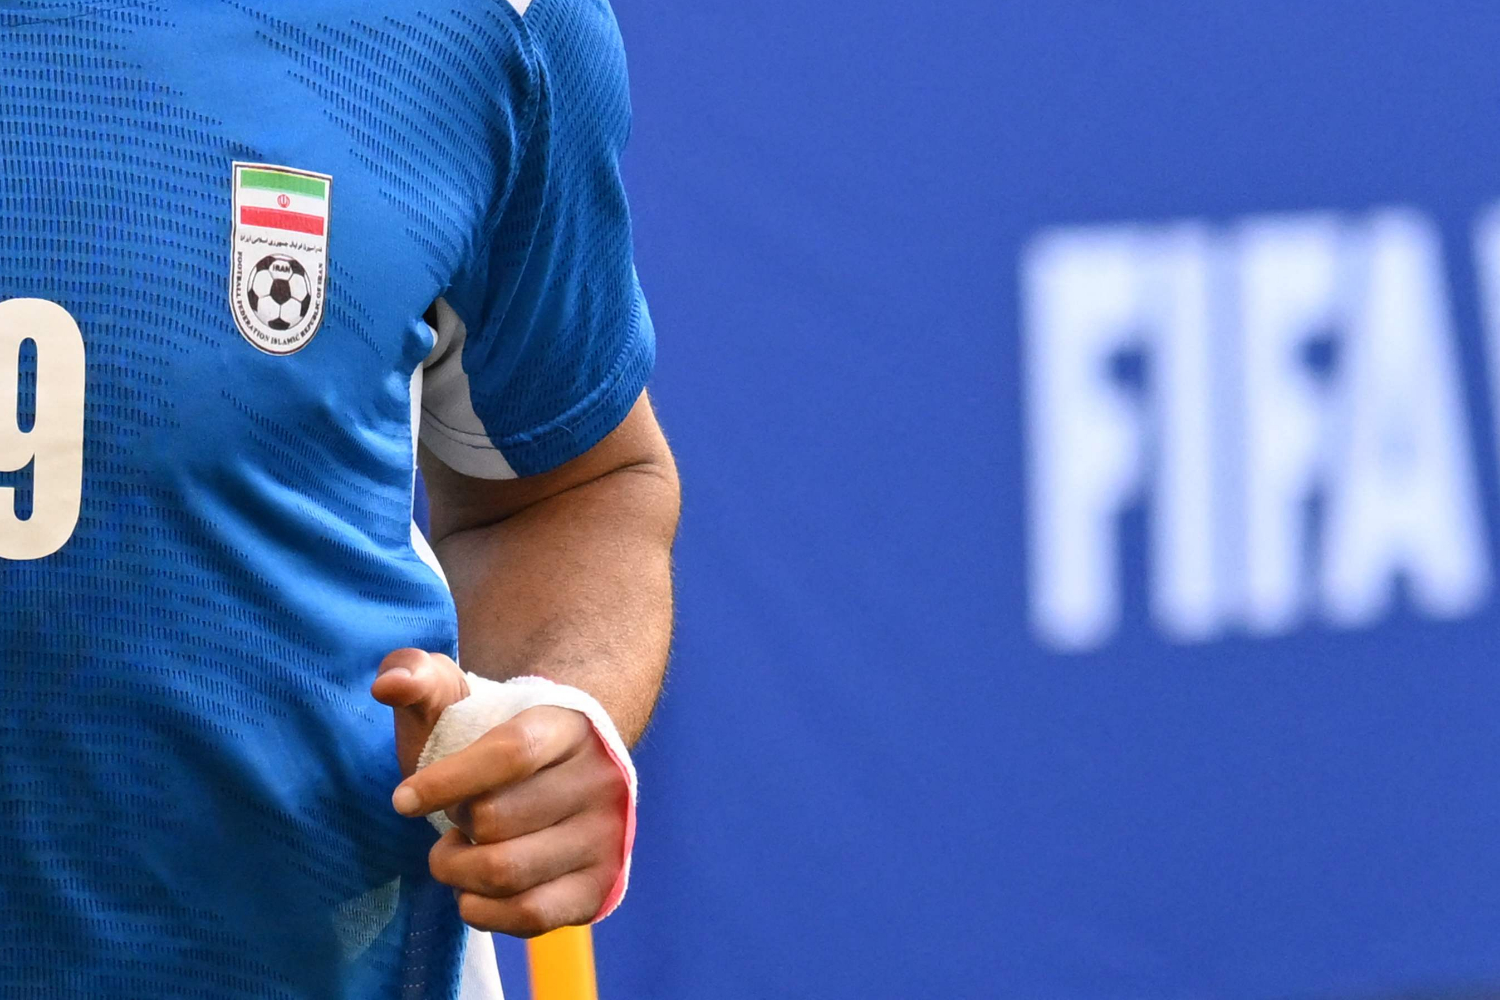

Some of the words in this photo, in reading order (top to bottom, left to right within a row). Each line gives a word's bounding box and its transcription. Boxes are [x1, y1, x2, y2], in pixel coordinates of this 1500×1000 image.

[272, 264, 290, 273] IRAN
[237, 300, 269, 342] FEDERATION
[271, 333, 300, 346] ISLAMIC
[300, 300, 321, 338] REPUBLIC
[316, 287, 322, 298] OF
[1020, 207, 1493, 651] FIFA
